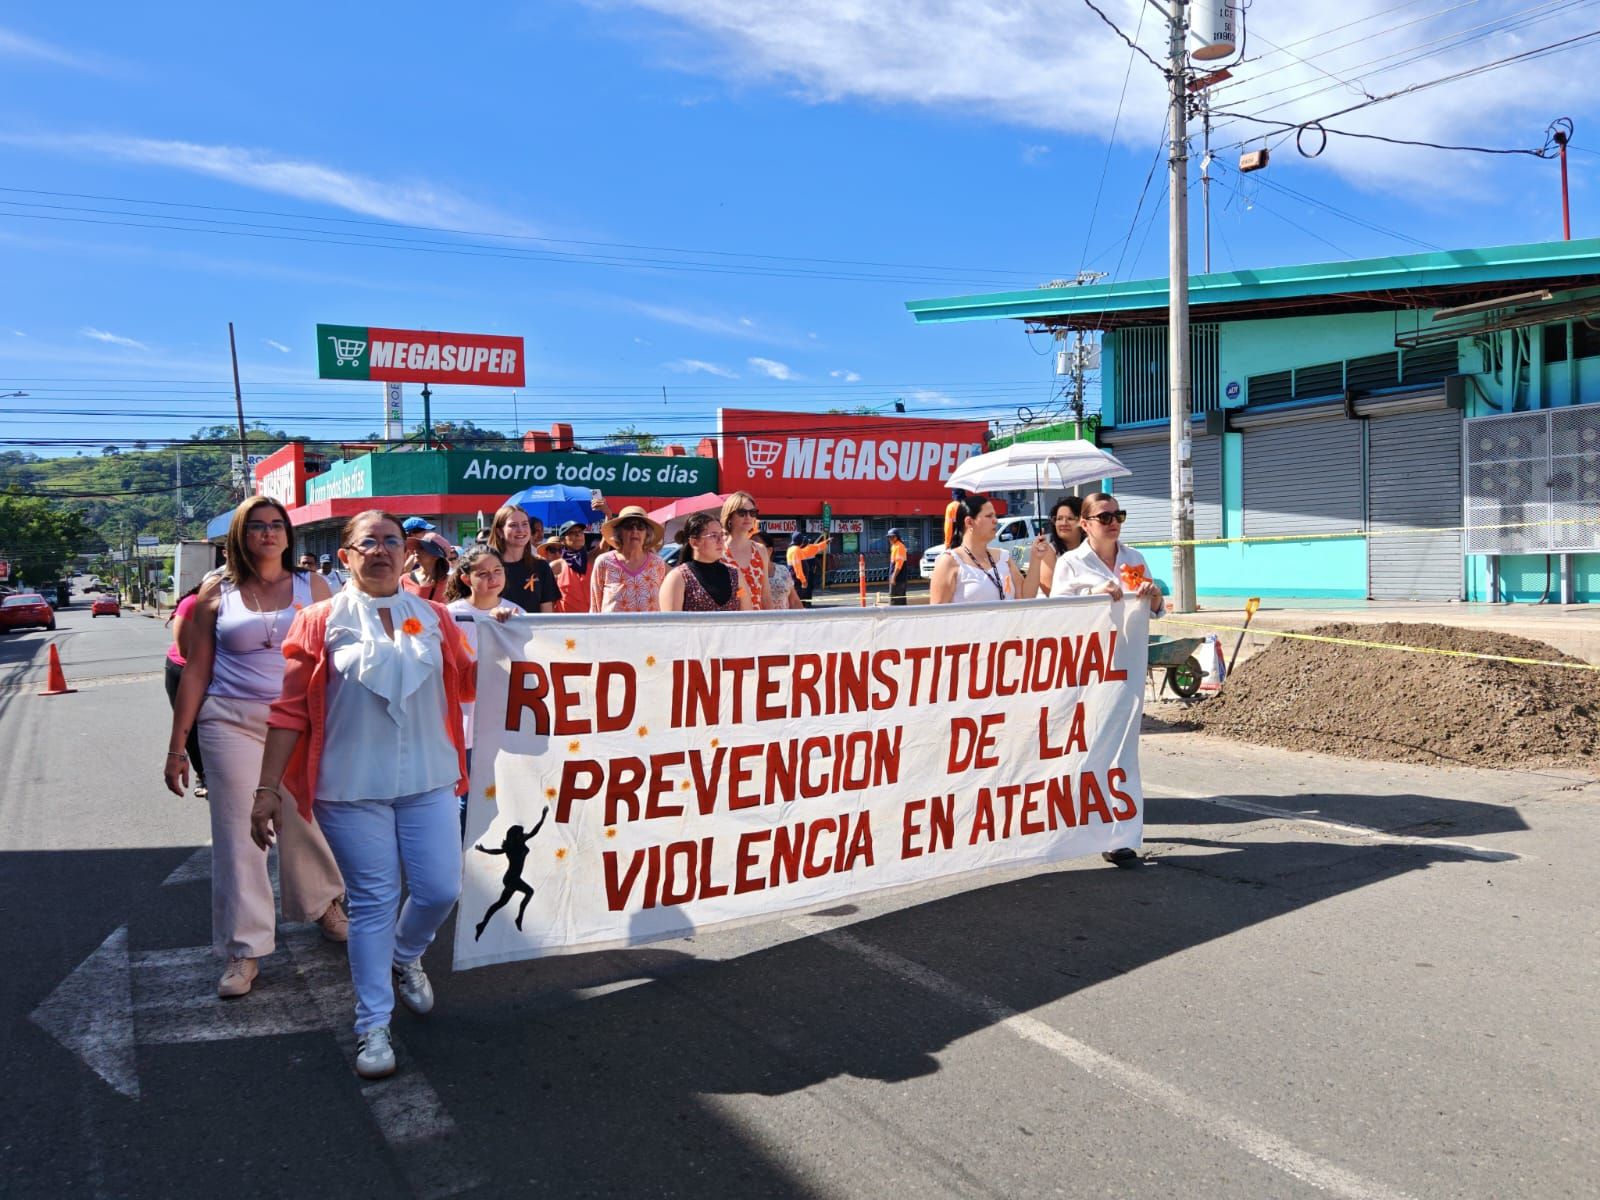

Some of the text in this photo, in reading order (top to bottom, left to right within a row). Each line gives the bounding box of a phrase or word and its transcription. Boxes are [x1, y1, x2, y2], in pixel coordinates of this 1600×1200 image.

[369, 340, 517, 375] MEGASUPER
[463, 458, 699, 484] Ahorro todos los días
[505, 631, 1128, 736] RED INTERINSTITUCIONAL
[555, 702, 1088, 827] PREVENCION DE LA
[602, 768, 1138, 911] VIOLENCIA EN ATENAS
